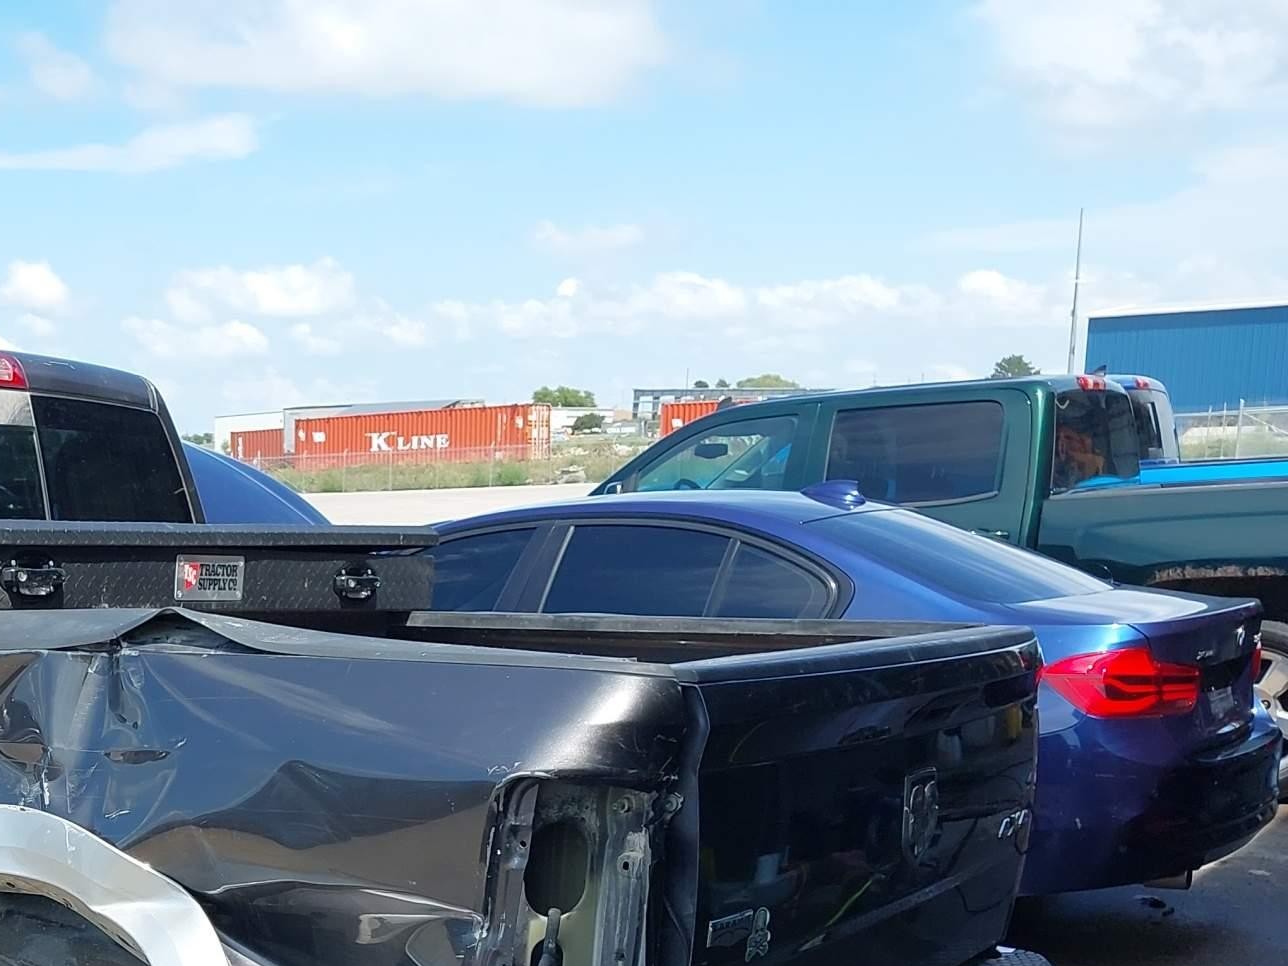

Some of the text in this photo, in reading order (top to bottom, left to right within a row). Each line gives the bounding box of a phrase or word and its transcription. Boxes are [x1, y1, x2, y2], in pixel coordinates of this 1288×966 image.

[365, 431, 449, 452] K LINE
[199, 563, 238, 577] TRACTOR
[198, 578, 228, 591] SUPPLY
